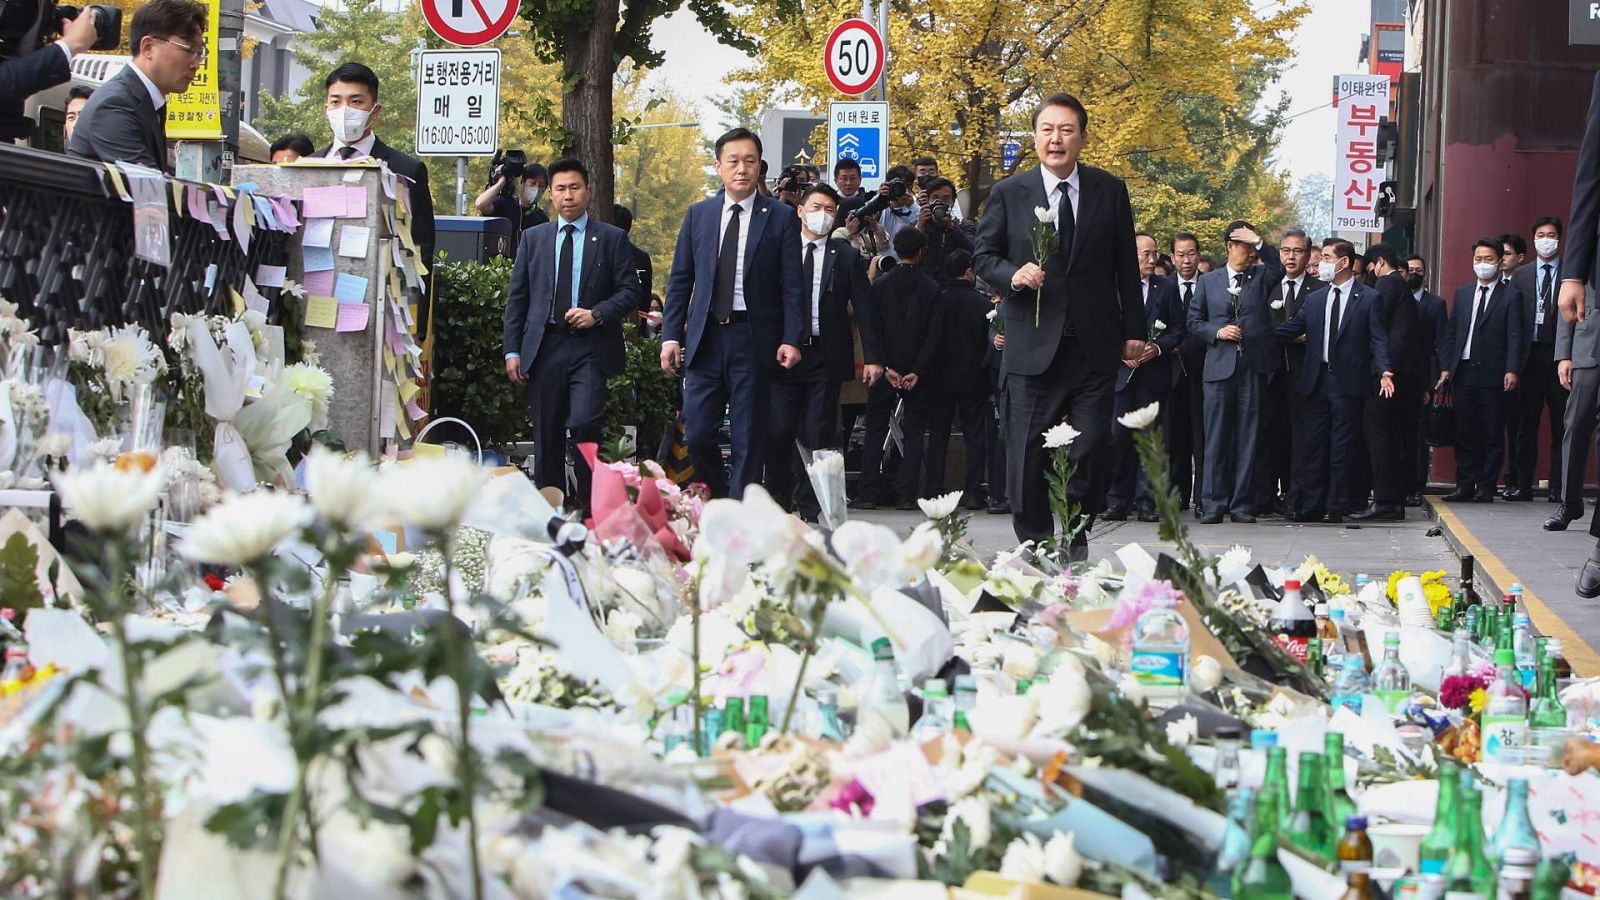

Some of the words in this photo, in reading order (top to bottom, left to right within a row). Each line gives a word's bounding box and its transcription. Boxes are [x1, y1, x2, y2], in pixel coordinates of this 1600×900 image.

[838, 38, 869, 76] 50
[423, 60, 496, 86] 보행전용거리
[1341, 80, 1387, 97] 이태원역
[168, 111, 204, 121] 울경찰청
[837, 110, 880, 124] 이태원로
[421, 125, 494, 145] (16:00~05:00)
[1343, 104, 1380, 211] 부동산
